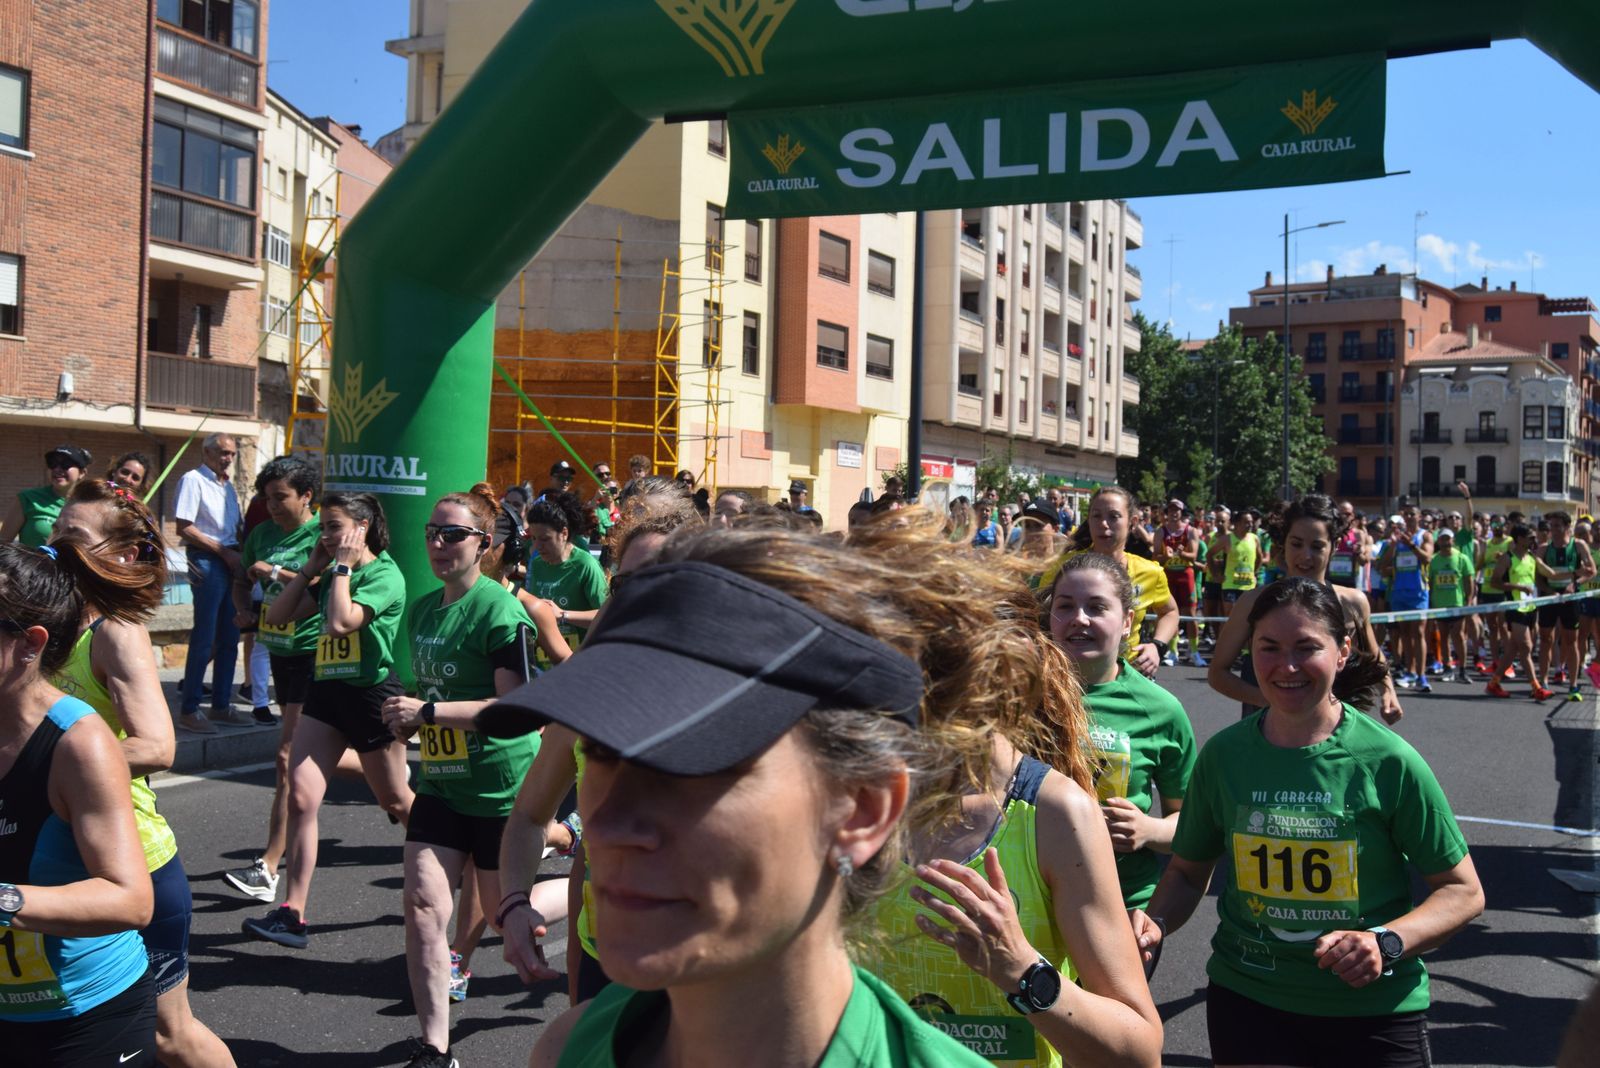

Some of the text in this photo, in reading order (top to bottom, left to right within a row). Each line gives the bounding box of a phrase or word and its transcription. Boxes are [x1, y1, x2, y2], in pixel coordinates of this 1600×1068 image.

[836, 99, 1240, 188] SALIDA
[1261, 136, 1356, 158] CAJA RURAL
[748, 177, 819, 192] CAJA RURAL
[322, 636, 351, 661] 119
[421, 726, 457, 757] 180
[442, 764, 467, 774] RURAL
[1252, 790, 1332, 804] VII CARRERA
[1267, 814, 1338, 828] FUNDACION
[1267, 826, 1338, 839] CAJA RURAL
[1250, 843, 1333, 894] 116
[1267, 906, 1351, 921] CAJA RURAL
[9, 988, 58, 1004] RURAL
